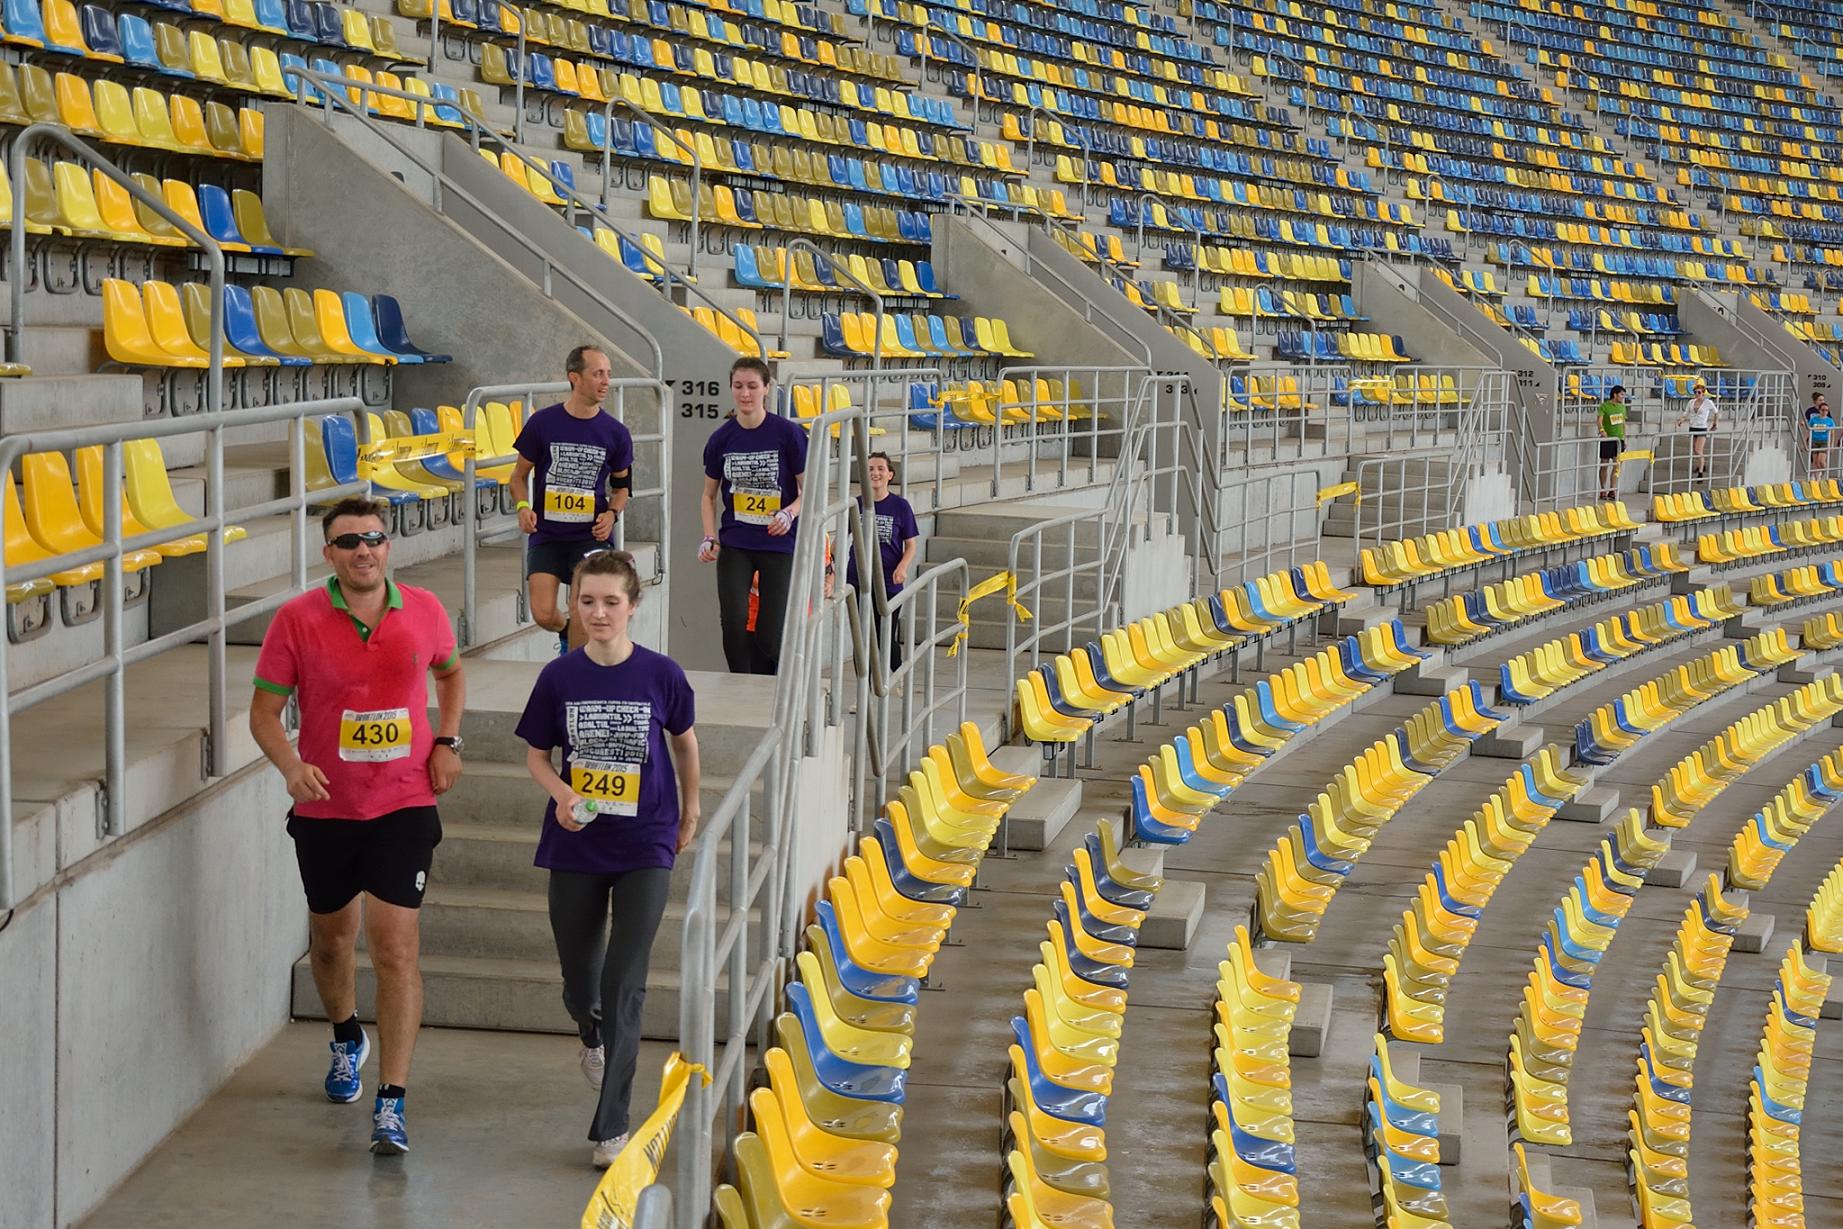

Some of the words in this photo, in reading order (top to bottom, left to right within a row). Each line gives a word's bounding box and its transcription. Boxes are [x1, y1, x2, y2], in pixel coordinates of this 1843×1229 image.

[682, 381, 719, 396] 316
[1165, 384, 1188, 394] 33
[681, 403, 719, 419] 315
[555, 495, 586, 510] 104
[746, 497, 766, 512] 24
[352, 722, 399, 745] 430
[581, 772, 625, 796] 249
